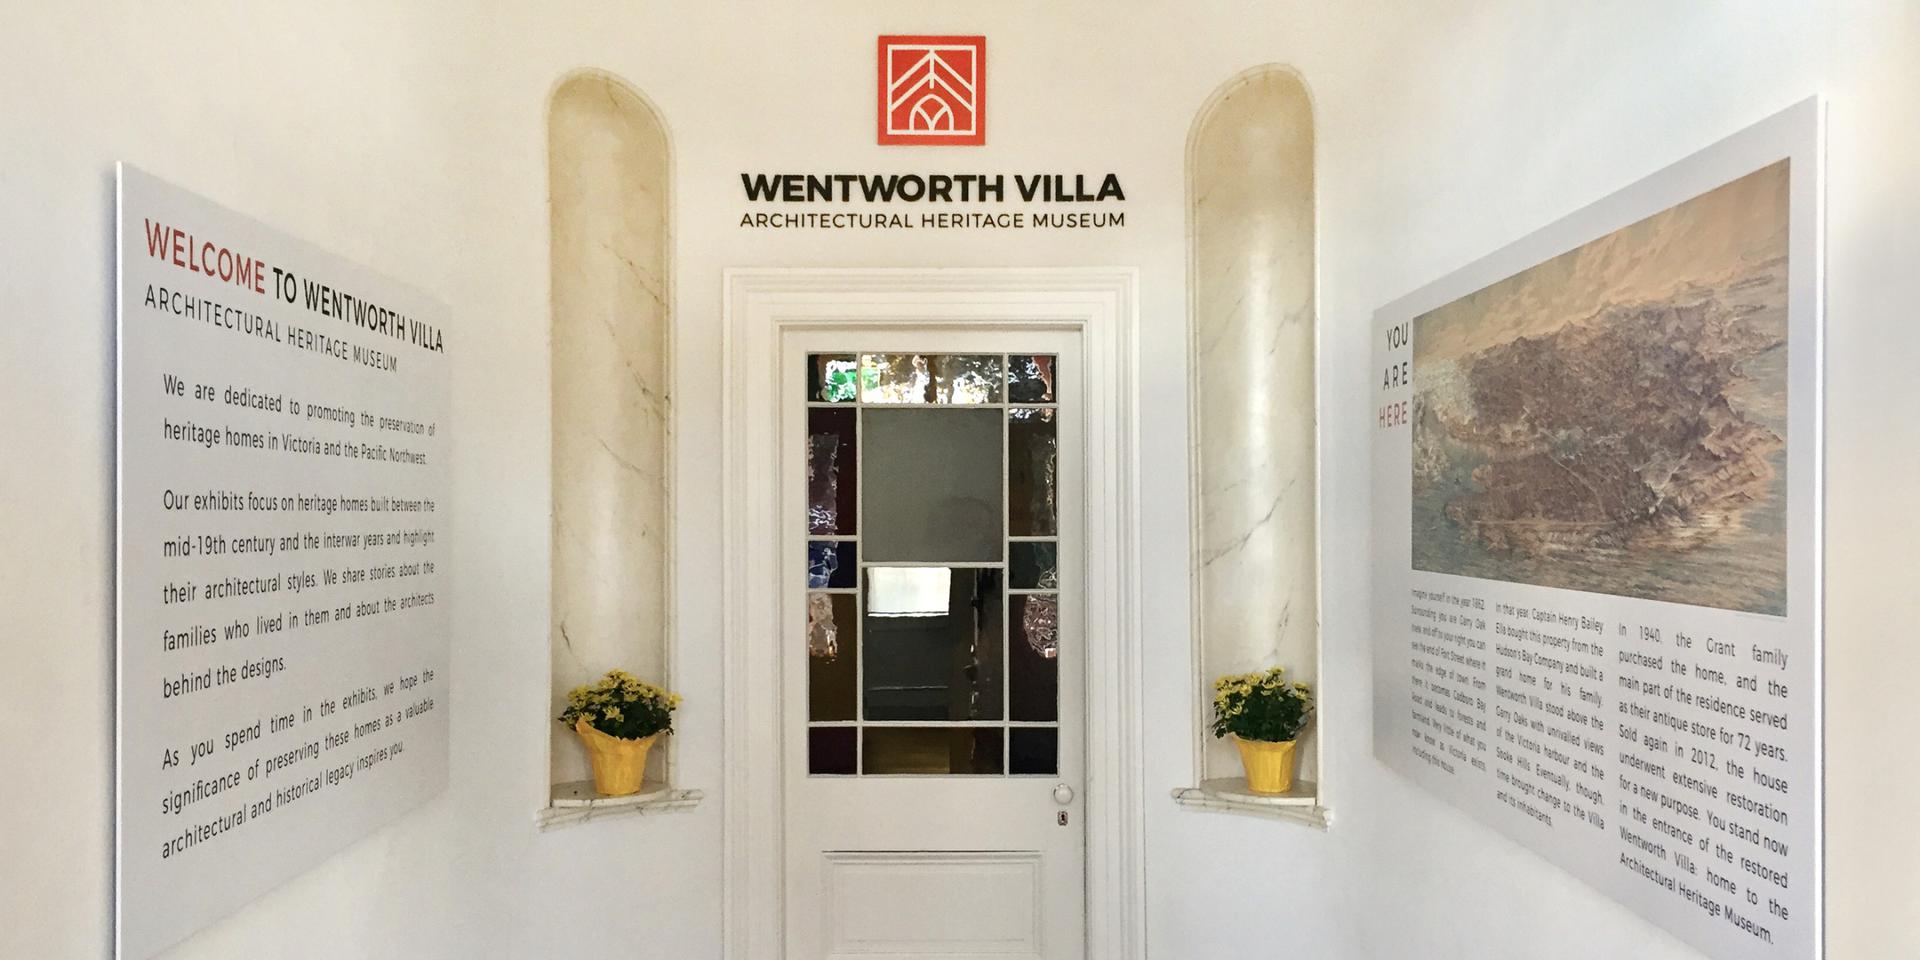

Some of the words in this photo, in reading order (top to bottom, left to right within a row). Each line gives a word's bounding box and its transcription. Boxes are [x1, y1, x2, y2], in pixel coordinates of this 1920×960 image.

[741, 173, 1003, 202] WENTWORTH
[1014, 174, 1125, 202] VILLA
[740, 213, 913, 228] ARCHITECTURAL
[922, 213, 1024, 228] HERITAGE
[1033, 213, 1124, 228] MUSEUM
[145, 218, 265, 294] WELCOME
[273, 267, 296, 303] TO
[304, 279, 405, 340] WENTWORTH
[410, 319, 443, 353] VILLA
[145, 284, 280, 342] ARCHITECTURAL
[288, 326, 347, 360] HERITAGE
[354, 345, 396, 372] MUSEUM
[1387, 322, 1408, 351] YOU
[163, 373, 184, 397] We
[195, 384, 215, 402] are
[224, 385, 282, 413] dedicated
[290, 398, 300, 415] to
[307, 404, 355, 428] promoting
[361, 411, 374, 427] the
[380, 417, 424, 434] preservation
[428, 423, 435, 436] of
[1384, 362, 1407, 390] ARE
[164, 417, 220, 448] heritage
[226, 425, 264, 449] homes
[268, 431, 278, 450] in
[282, 433, 320, 454] Victoria
[324, 440, 341, 456] and
[344, 441, 358, 459] the
[361, 443, 387, 461] Pacific
[1379, 401, 1407, 428] HERE
[164, 489, 189, 510] Our
[194, 490, 244, 511] exhibits
[248, 491, 278, 511] focus
[281, 497, 294, 511] on
[298, 493, 337, 515] heritage
[340, 494, 368, 512] homes
[424, 497, 435, 512] the
[164, 534, 226, 557] mid-19th
[232, 536, 275, 556] century
[280, 532, 299, 551] and
[304, 532, 319, 550] the
[324, 532, 360, 548] interwar
[363, 534, 384, 550] years
[387, 530, 400, 545] and
[164, 581, 197, 605] their
[205, 573, 280, 600] architectural
[323, 569, 337, 586] We
[342, 567, 365, 583] share
[370, 563, 396, 580] stories
[399, 562, 419, 577] about
[423, 560, 435, 574] the
[164, 625, 216, 652] families
[224, 619, 249, 641] who
[257, 612, 282, 635] lived
[289, 611, 298, 629] in
[305, 609, 329, 626] them
[335, 603, 351, 621] and
[356, 600, 379, 617] about
[384, 596, 396, 613] the
[400, 592, 434, 610] architects
[1618, 623, 1627, 636] In
[1675, 631, 1692, 649] the
[1706, 637, 1736, 658] Grant
[1751, 643, 1789, 671] family
[164, 668, 211, 699] behind
[217, 665, 237, 686] the
[241, 657, 286, 680] designs.
[1618, 650, 1663, 671] purchased
[1670, 659, 1687, 676] the
[1735, 675, 1757, 692] and
[1767, 680, 1788, 699] the
[1618, 675, 1640, 691] main
[1642, 682, 1661, 697] part
[1663, 684, 1674, 699] of
[1676, 687, 1692, 705] the
[1695, 695, 1746, 720] residence
[1749, 708, 1788, 730] served
[162, 748, 179, 770] As
[191, 739, 214, 765] you
[225, 719, 261, 751] spend
[271, 713, 294, 734] time
[303, 705, 312, 723] in
[321, 699, 335, 717] the
[384, 682, 394, 696] we
[400, 675, 417, 691] hope
[423, 668, 434, 684] the
[1618, 701, 1628, 714] as
[1629, 702, 1651, 720] their
[1652, 711, 1689, 732] antique
[1690, 721, 1717, 741] store
[1719, 726, 1735, 745] for
[1737, 732, 1752, 752] 72
[1754, 741, 1788, 762] years.
[162, 771, 240, 815] significance
[248, 758, 259, 781] of
[266, 741, 319, 778] preserving
[325, 730, 349, 751] these
[354, 719, 381, 739] homes
[385, 714, 393, 727] as
[396, 711, 401, 723] a
[405, 697, 434, 719] valuable
[1618, 723, 1638, 743] Sold
[1643, 734, 1668, 753] again
[1674, 745, 1684, 758] in
[1726, 759, 1745, 779] the
[1753, 767, 1789, 794] house
[162, 803, 246, 859] architectural
[251, 792, 272, 819] and
[276, 771, 322, 808] historical
[326, 762, 354, 786] legacy
[357, 748, 388, 772] inspires
[1619, 752, 1666, 780] underwent
[1672, 771, 1718, 799] extensive
[1726, 791, 1788, 826] restoration
[1619, 774, 1631, 791] for
[1632, 783, 1639, 795] a
[1640, 785, 1659, 803] new
[1706, 809, 1726, 832] You
[1728, 822, 1760, 846] stand
[1763, 835, 1789, 857] now
[1619, 803, 1628, 815] in
[1632, 807, 1647, 825] the
[1652, 817, 1693, 846] entrance
[1698, 837, 1710, 853] of
[1715, 843, 1734, 864] the
[1740, 857, 1789, 889] restored
[1619, 825, 1667, 861] Wentworth
[1706, 866, 1737, 896] home
[1746, 887, 1759, 906] to
[1768, 898, 1789, 921] the
[1619, 852, 1676, 892] Architectural
[1678, 882, 1721, 917] Heritage
[1724, 904, 1774, 944] Museum.
